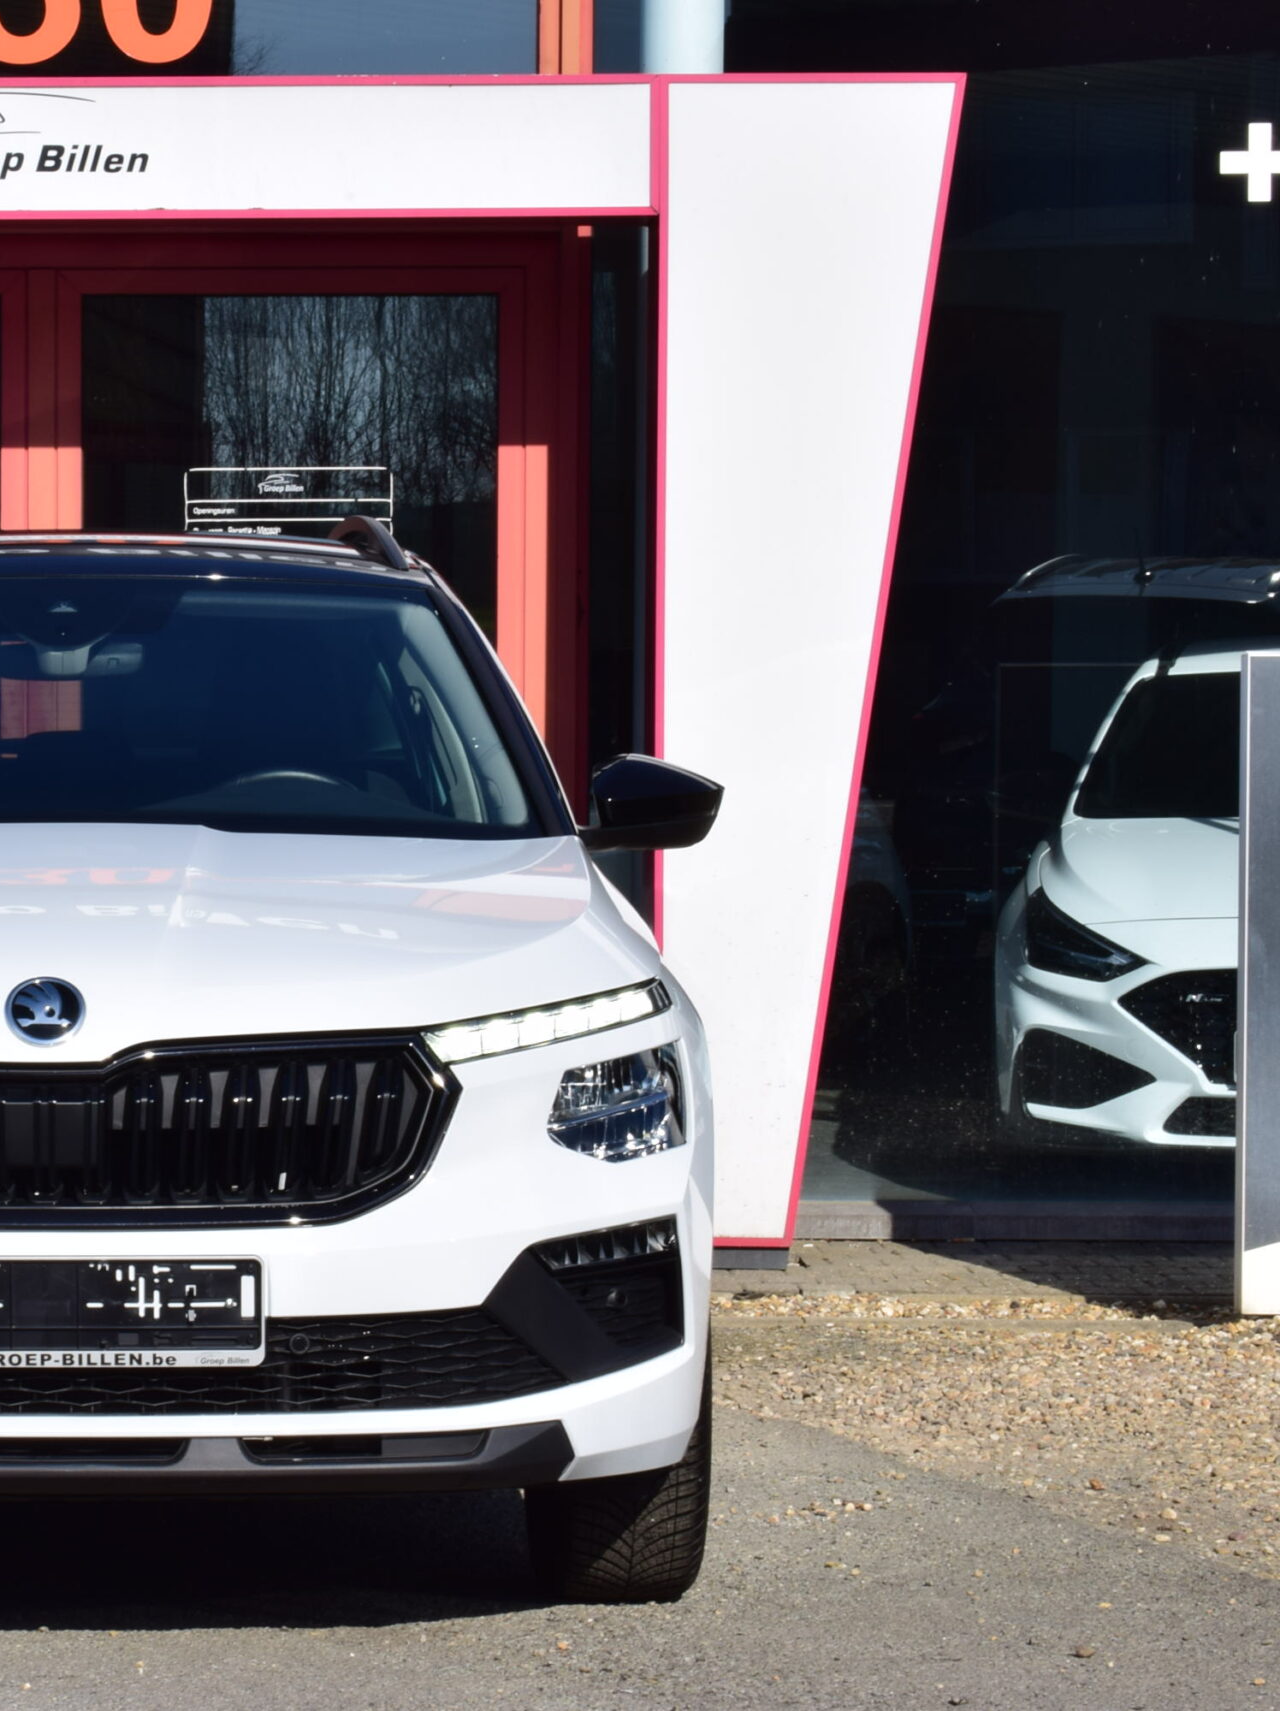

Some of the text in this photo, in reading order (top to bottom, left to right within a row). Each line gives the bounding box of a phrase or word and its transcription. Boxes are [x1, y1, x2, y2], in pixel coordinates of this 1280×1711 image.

[35, 144, 150, 174] Billen
[199, 1356, 250, 1366] Groep Billen
